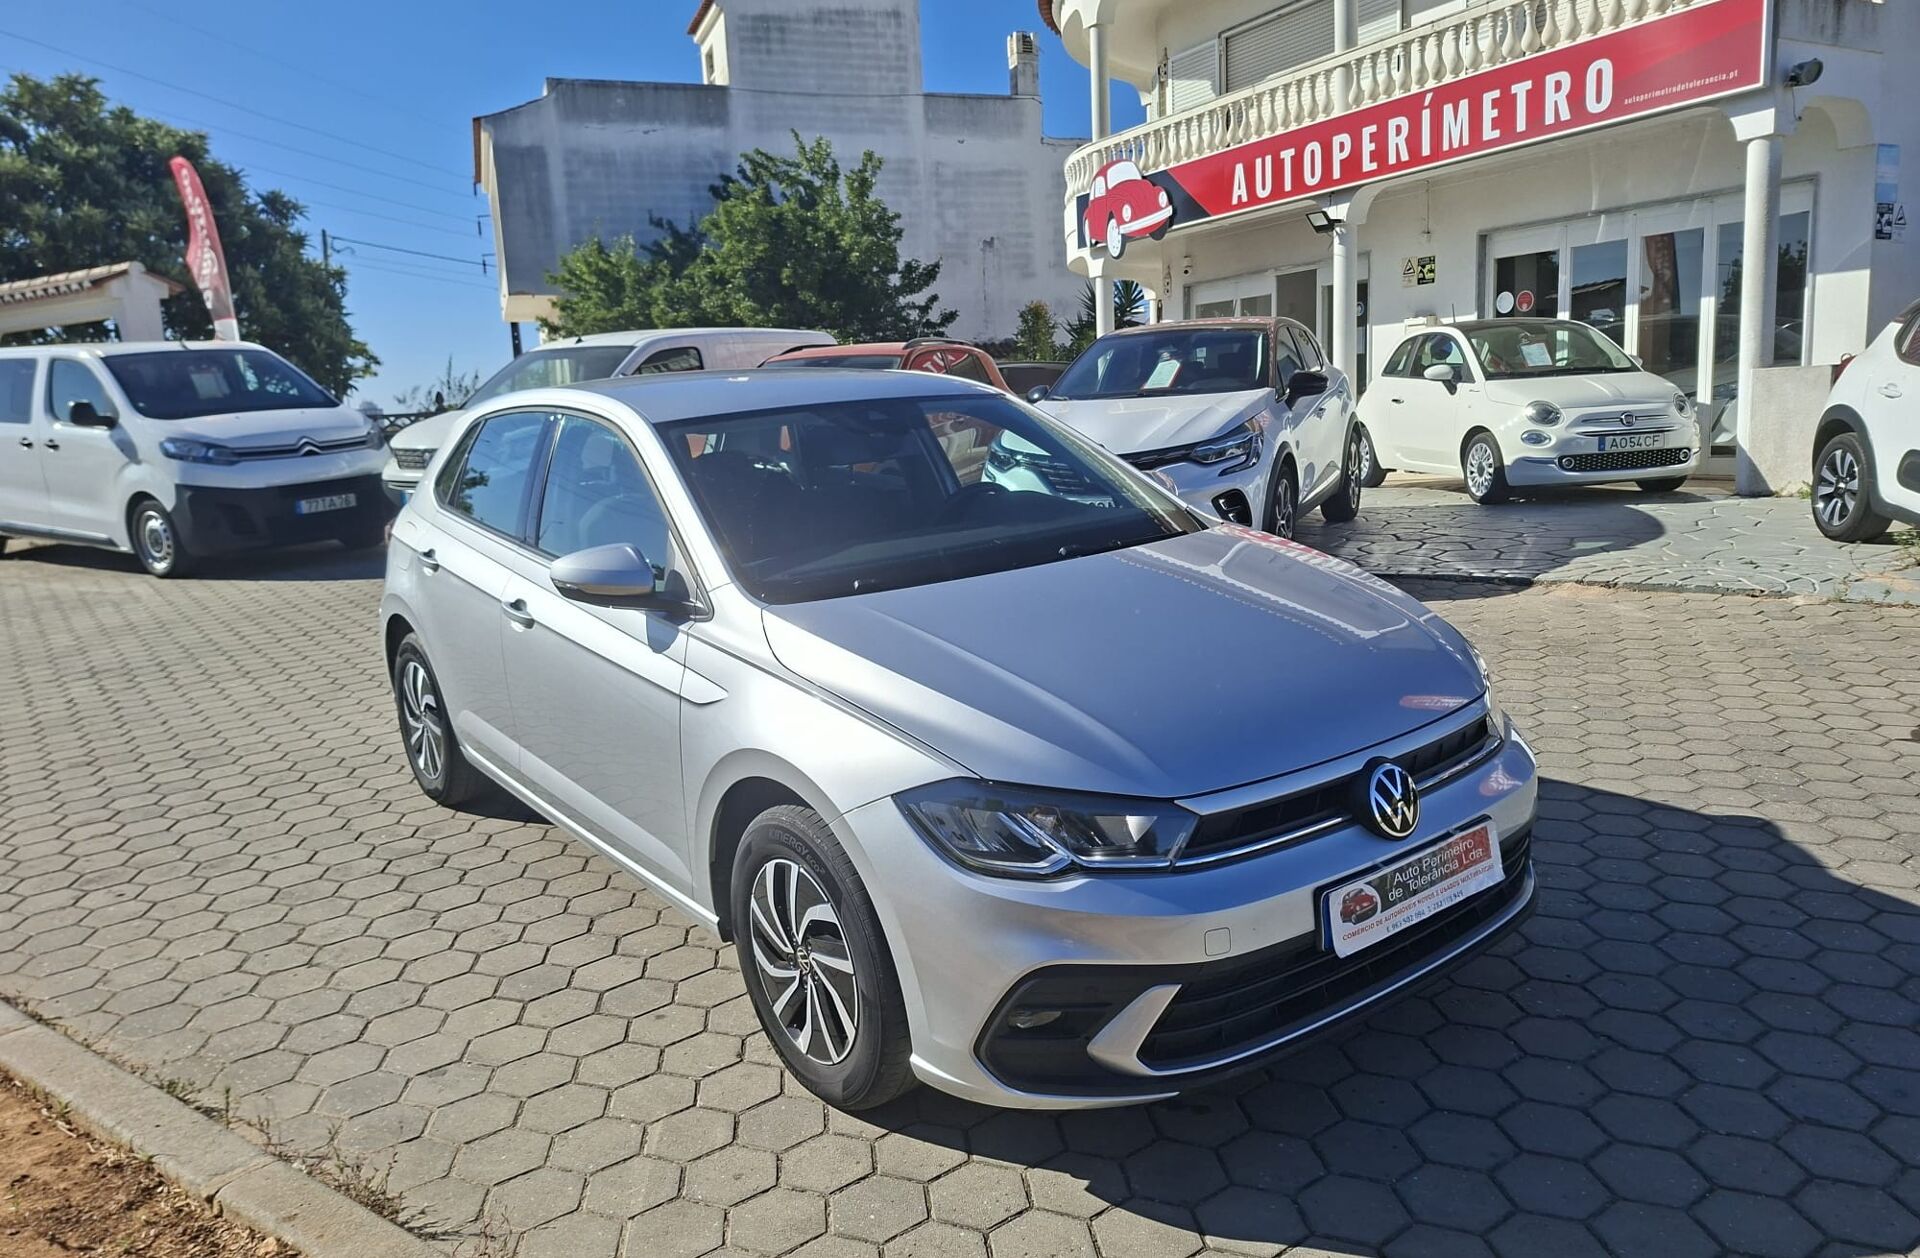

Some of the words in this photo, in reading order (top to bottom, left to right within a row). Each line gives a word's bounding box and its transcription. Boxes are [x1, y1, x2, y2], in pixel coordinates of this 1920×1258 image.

[1231, 58, 1614, 206] AUTOPERÍMETRO
[1388, 886, 1403, 901] de
[1406, 859, 1459, 892] Tolerância
[1393, 865, 1420, 886] Auto
